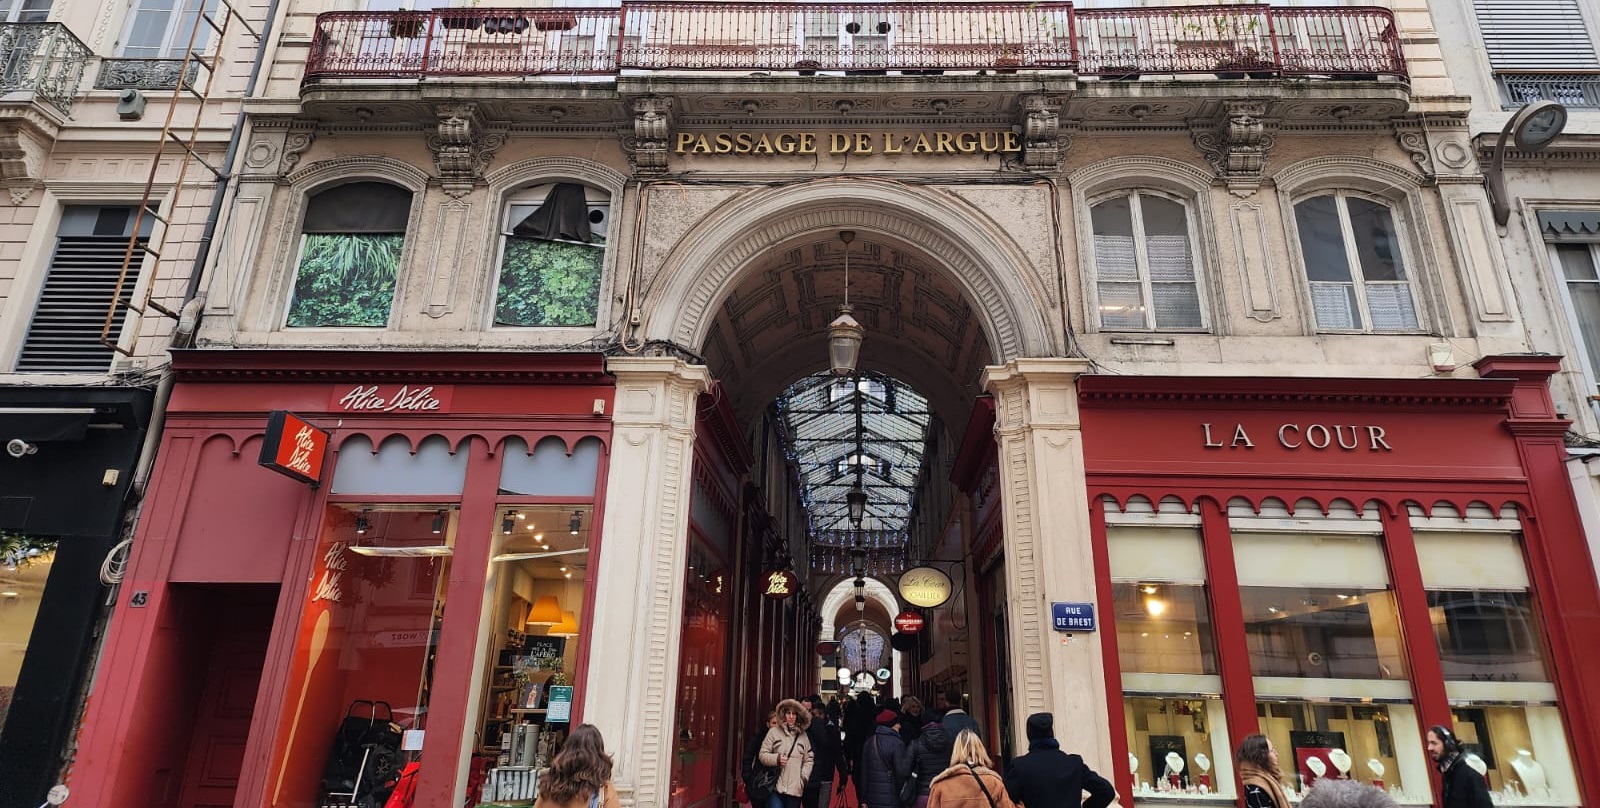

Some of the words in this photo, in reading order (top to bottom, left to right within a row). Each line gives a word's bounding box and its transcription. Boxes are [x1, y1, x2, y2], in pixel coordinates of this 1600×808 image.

[676, 131, 817, 155] PASSAGE
[829, 131, 873, 155] DE
[883, 131, 1022, 155] L'ARGUE
[339, 385, 385, 410] Alice
[384, 385, 440, 412] Délice
[295, 425, 315, 452] Alice
[1202, 423, 1255, 448] LA
[1278, 423, 1393, 450] COUR
[286, 446, 311, 474] Délice
[323, 541, 347, 571] Alice
[902, 575, 920, 587] La
[1056, 617, 1067, 626] DE
[1068, 617, 1092, 627] BREST
[1065, 606, 1082, 615] RUE
